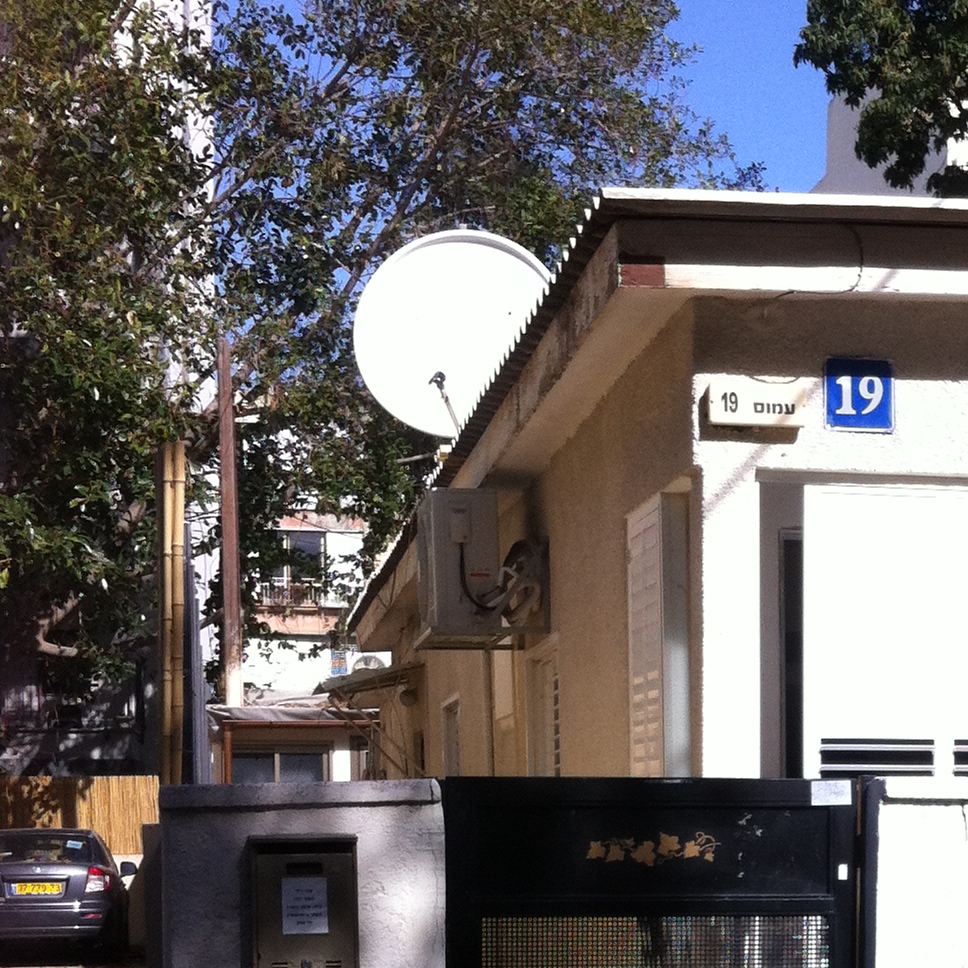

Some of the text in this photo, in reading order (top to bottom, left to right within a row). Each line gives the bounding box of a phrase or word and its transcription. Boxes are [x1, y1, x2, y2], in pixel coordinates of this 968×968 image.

[721, 392, 795, 415] עמוס 19
[835, 375, 885, 416] 19
